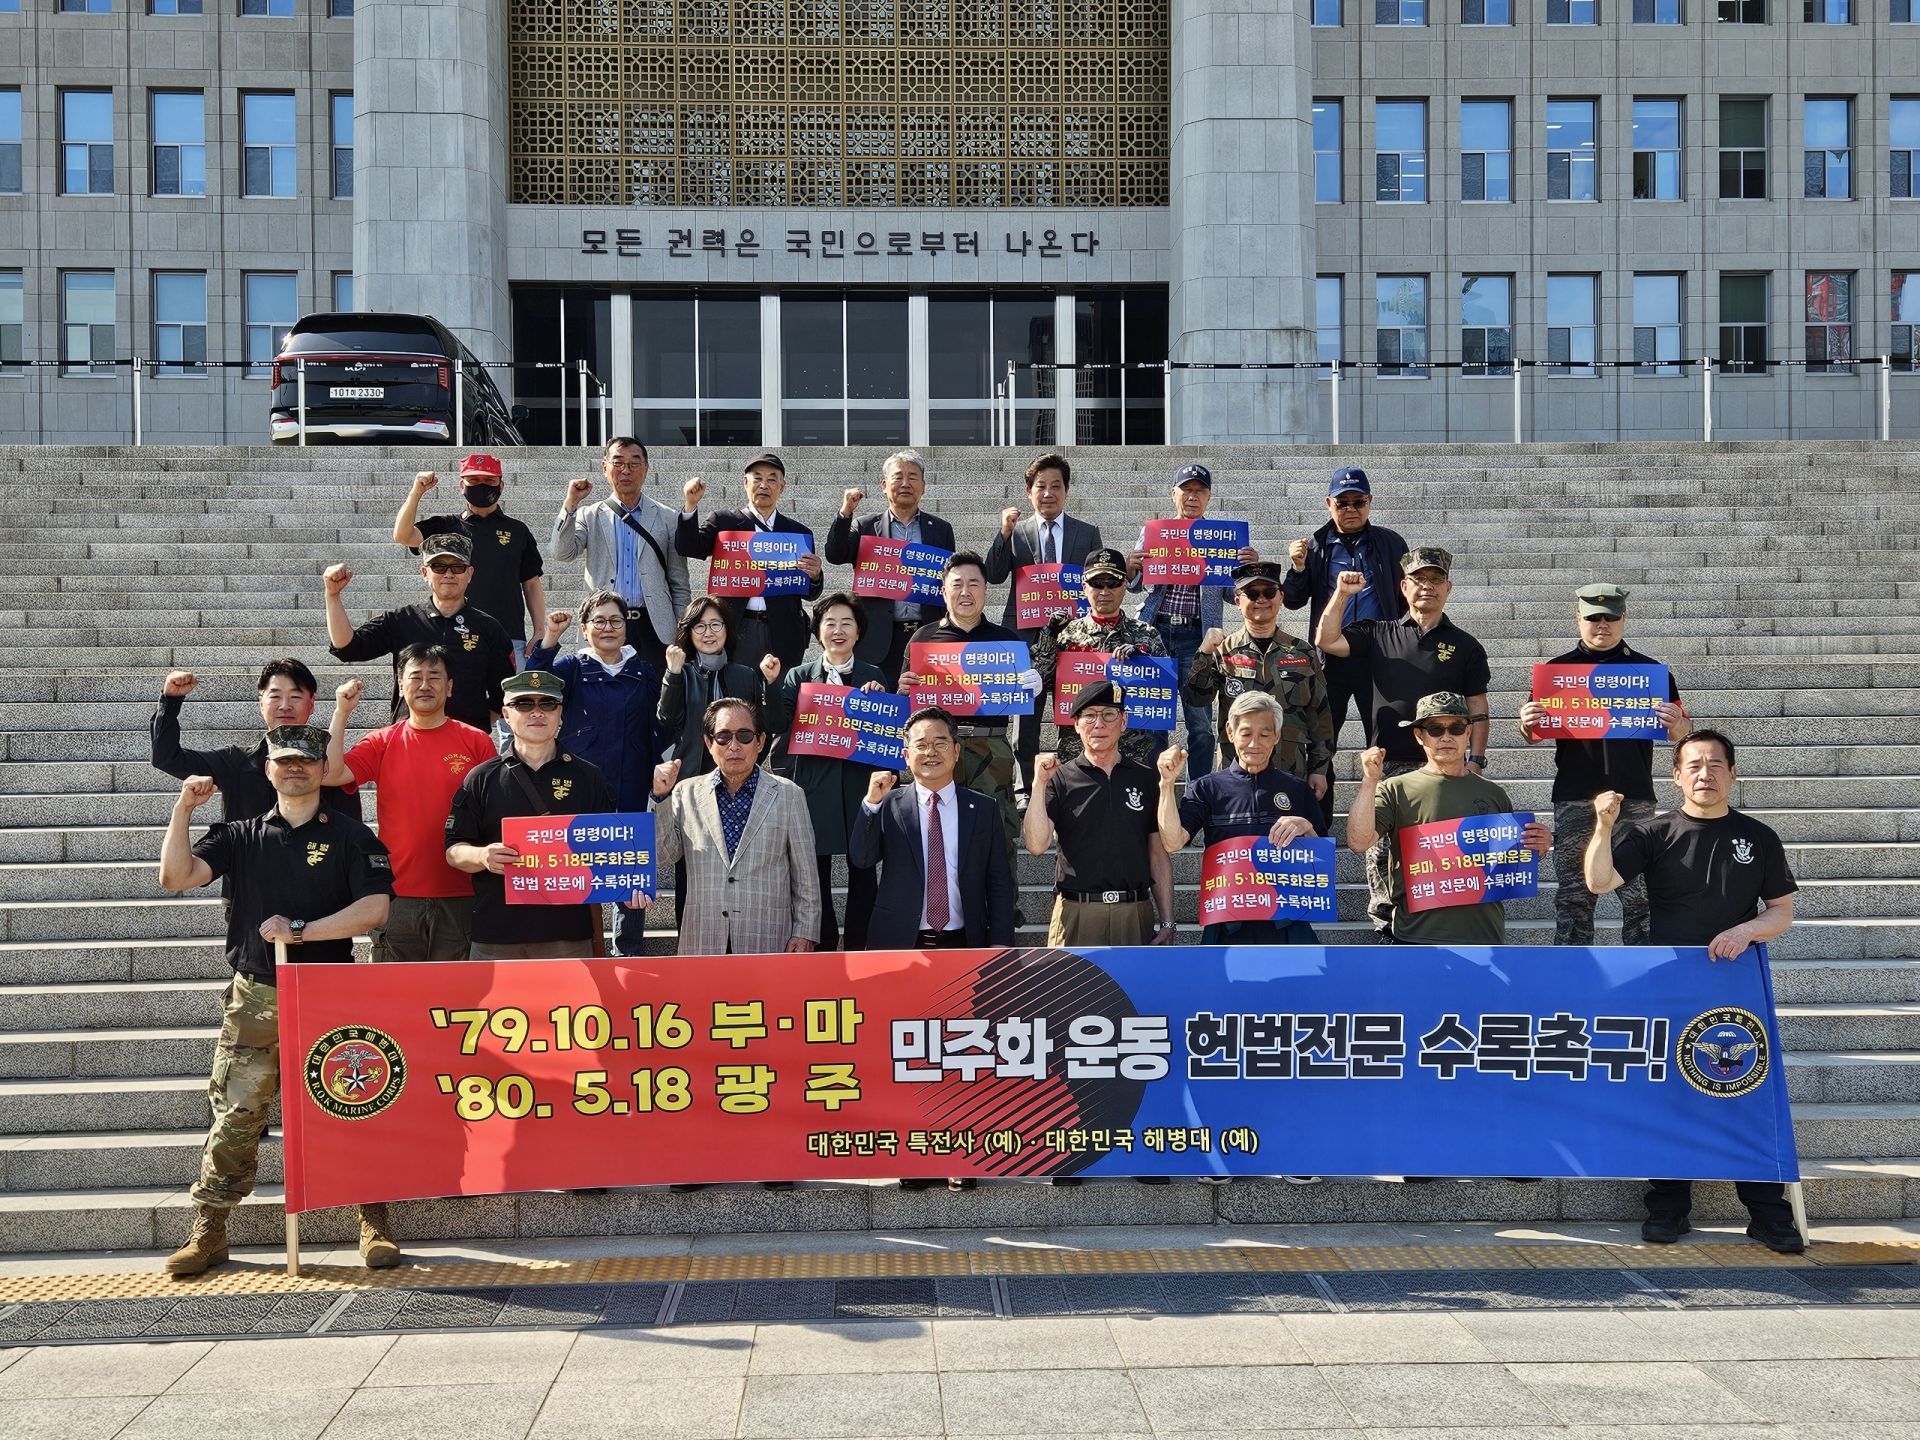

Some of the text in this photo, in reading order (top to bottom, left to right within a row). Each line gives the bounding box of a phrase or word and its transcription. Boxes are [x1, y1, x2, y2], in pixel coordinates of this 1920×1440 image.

[582, 228, 1100, 258] 모든 권력은 국민으로부터 나온다
[358, 388, 381, 397] 2330
[1160, 529, 1236, 541] 국민의 명령이다!
[722, 540, 797, 553] 국민의 명령이다!
[873, 545, 902, 558] 국민의
[1174, 548, 1237, 559] 5·18민주화운
[1030, 572, 1060, 583] 국민의
[1148, 565, 1239, 576] 헌법 전문에 수록하
[711, 575, 806, 588] 헌법 전문에 수록하라!
[857, 577, 875, 588] 헌법
[878, 578, 908, 592] 전문에
[1021, 607, 1040, 619] 헌법
[927, 652, 1015, 666] 국민의 명령이다!
[1073, 663, 1160, 679] 국민의 명령이다!
[1552, 676, 1649, 689] 국민의 명령이다!
[813, 694, 898, 717] 국민의 명령이다!
[915, 692, 1029, 705] 헌법 전문에 수록하라!
[1539, 716, 1562, 729] 헌법
[1567, 716, 1604, 729] 전문에
[795, 732, 814, 743] 헌법
[818, 733, 851, 748] 전문에
[526, 826, 634, 844] 국민의 명령이다!
[1419, 826, 1518, 850] 국민의 명령이다!
[548, 851, 650, 867] 5·18민주화운동
[1216, 848, 1314, 864] 국민의 명령이다!
[1409, 849, 1532, 876] 부마, 5·18민주화운동
[511, 874, 651, 891] 헌법 전문에 수록하라!
[1205, 872, 1329, 891] 부마, 5·18민주화운동
[1410, 871, 1532, 899] 헌법 전문에 수록하라!
[1204, 893, 1331, 912] 헌법 전문에 수록하라!
[890, 1010, 1671, 1084] 민주화 운동 헌법전문 수록촉구!
[1683, 1054, 1766, 1091] NOTHING IS IMPOSSIBLE
[332, 1102, 377, 1115] MARINE
[376, 1076, 401, 1107] CORPS
[806, 1130, 900, 1157] 대한민국
[906, 1130, 977, 1155] 특전사
[983, 1129, 1022, 1155] (예)
[1044, 1128, 1135, 1154] 대한민국
[1142, 1127, 1211, 1153] 해병대
[1219, 1128, 1259, 1155] (예)
